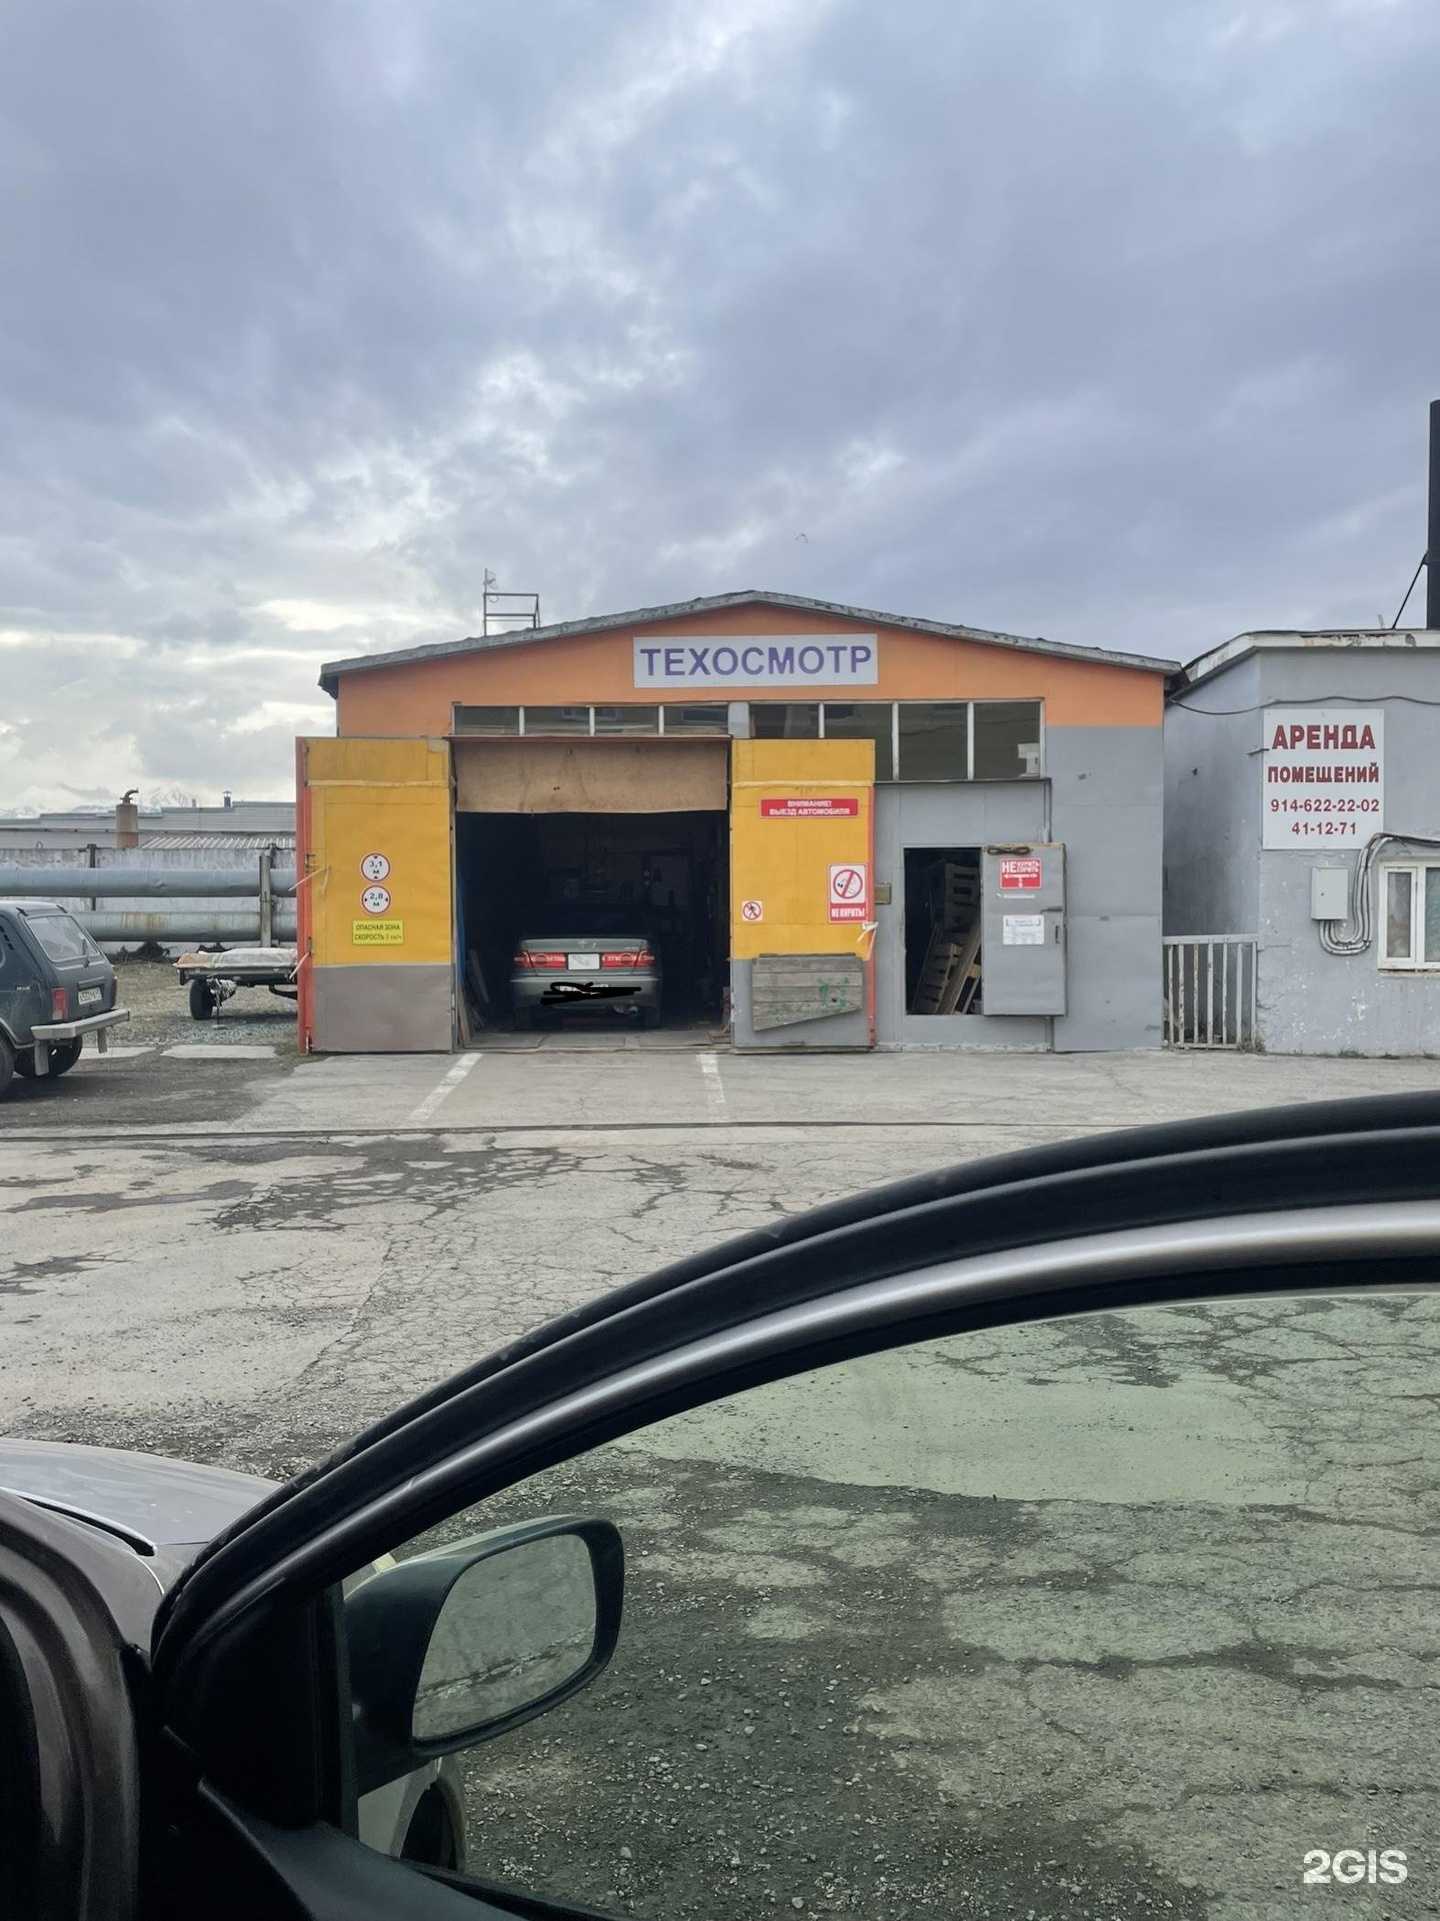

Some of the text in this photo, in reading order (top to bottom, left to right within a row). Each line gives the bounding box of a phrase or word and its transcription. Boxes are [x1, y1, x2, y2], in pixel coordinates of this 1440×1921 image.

[640, 646, 871, 676] ТЕХОСМОТР
[1272, 725, 1376, 749] АРЕНДА
[1268, 762, 1379, 782] ПОМЕЩЕНИЙ
[769, 808, 797, 816] ВЫЕЗД
[1271, 799, 1379, 812] 914-622-22-02
[1292, 822, 1356, 835] 41-12-71
[1002, 861, 1016, 873] НЕ
